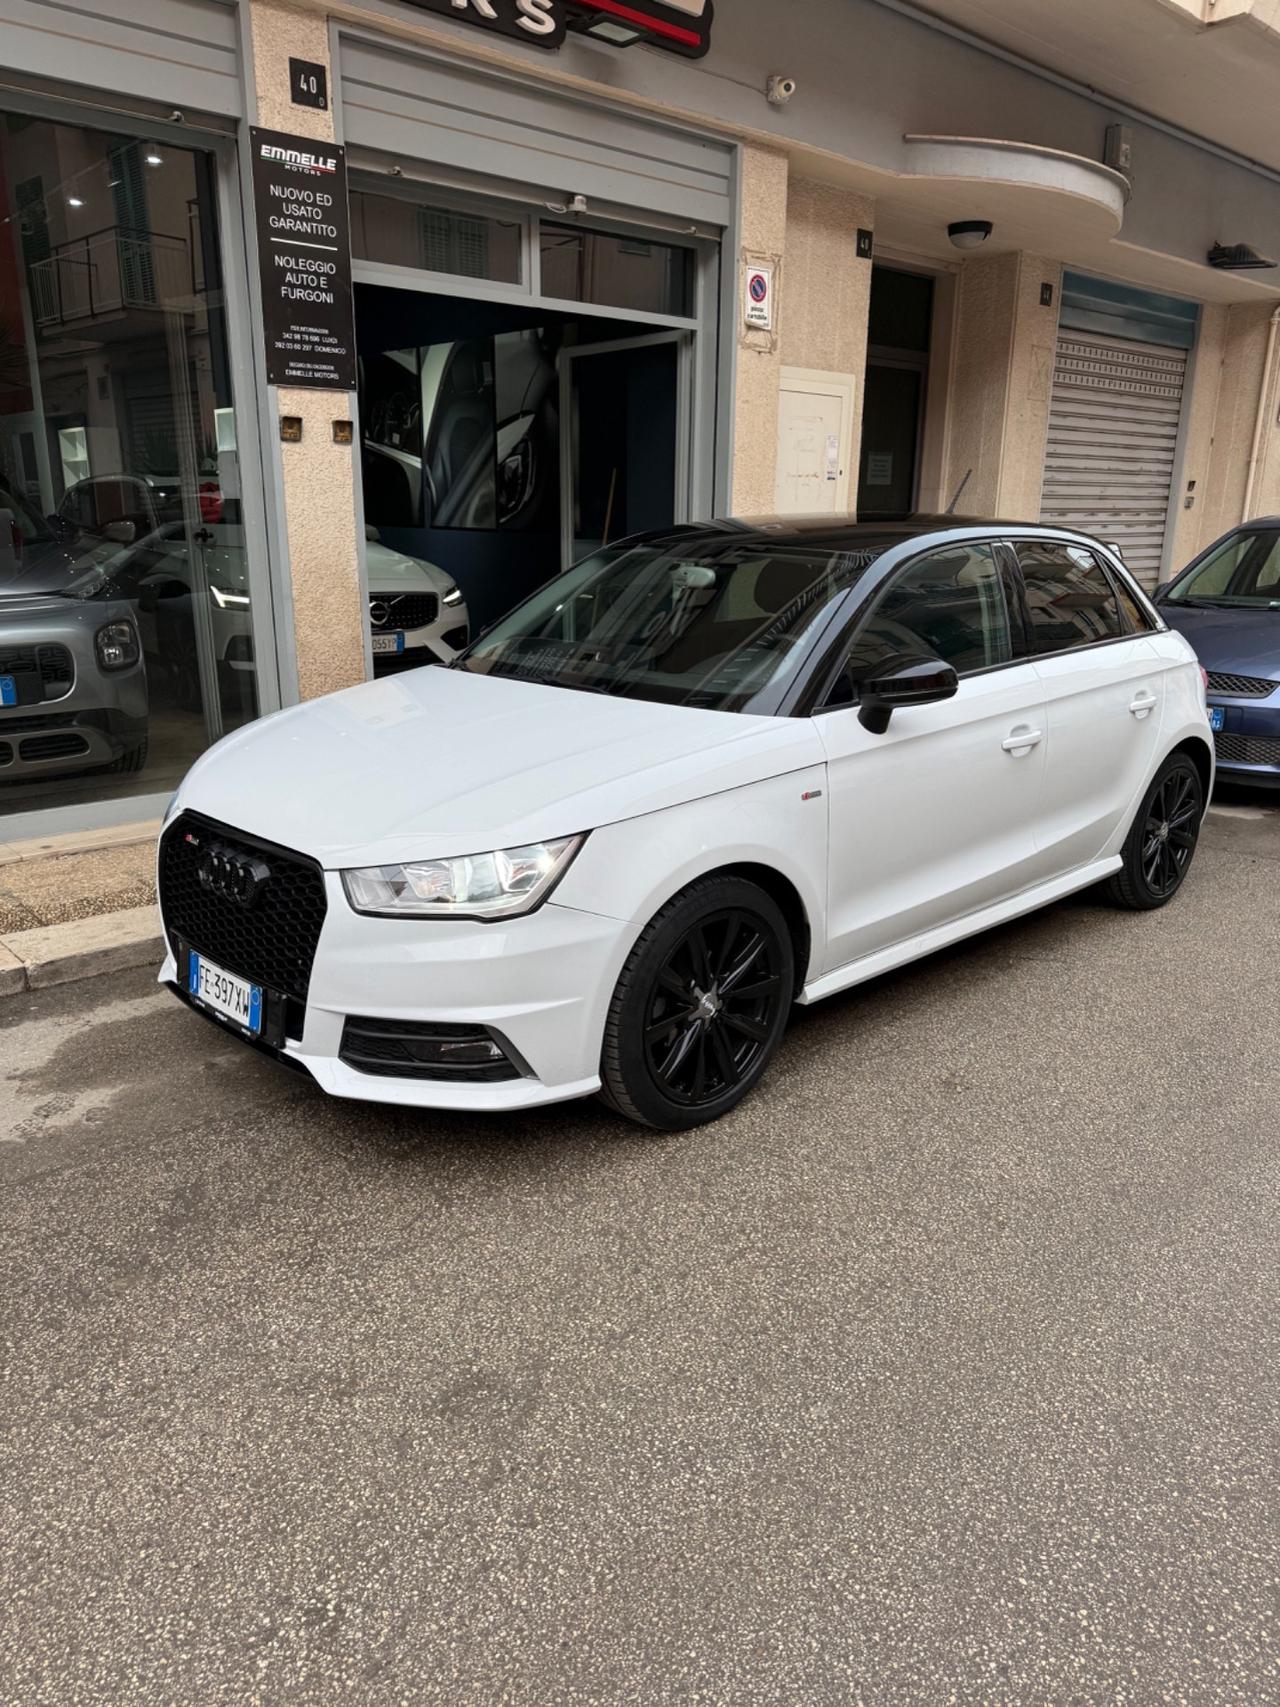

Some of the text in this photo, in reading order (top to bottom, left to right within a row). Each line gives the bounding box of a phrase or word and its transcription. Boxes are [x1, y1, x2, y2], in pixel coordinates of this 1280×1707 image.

[300, 74, 317, 94] 40
[261, 144, 336, 170] EMMELLE
[284, 164, 321, 176] MOTORS
[270, 184, 332, 206] NUOVO ED
[283, 202, 322, 220] USATO
[269, 216, 337, 238] GARANTITO
[274, 255, 336, 275] NOLEGGIO
[285, 272, 328, 288] AUTO E
[281, 286, 334, 304] FURGONI
[314, 371, 339, 380] MOTORS
